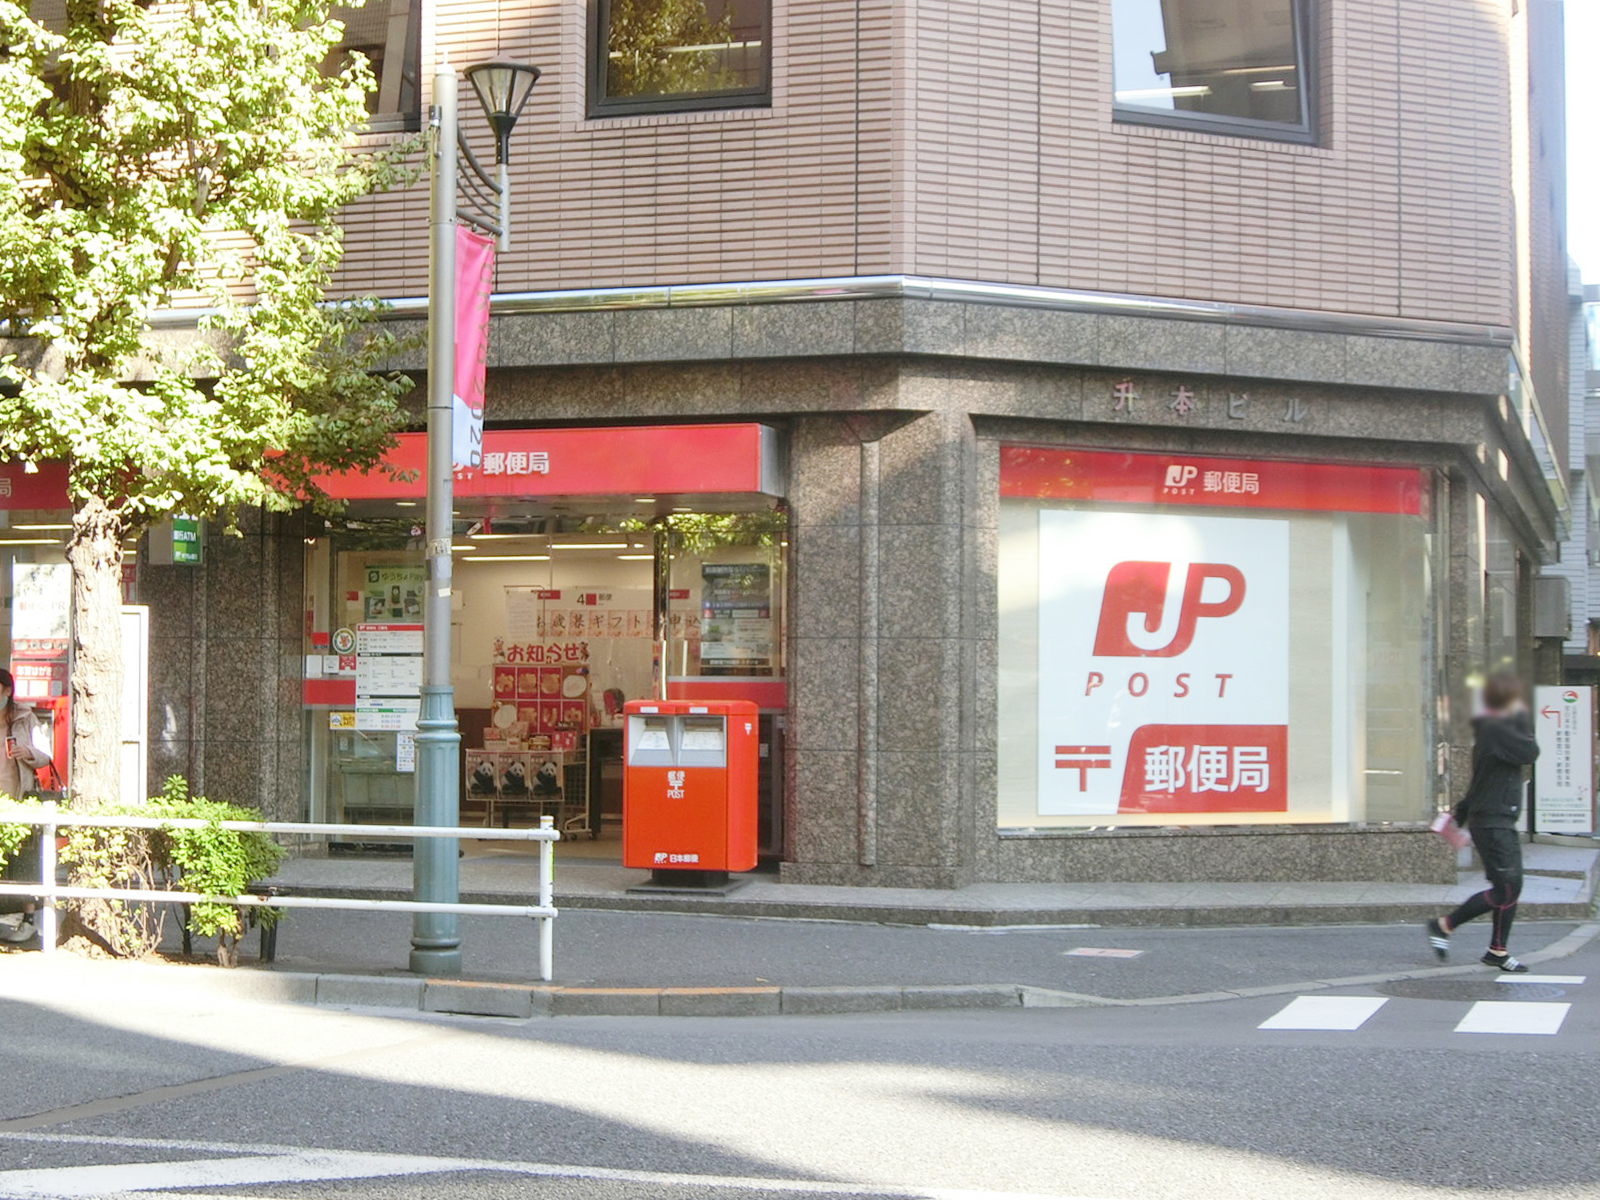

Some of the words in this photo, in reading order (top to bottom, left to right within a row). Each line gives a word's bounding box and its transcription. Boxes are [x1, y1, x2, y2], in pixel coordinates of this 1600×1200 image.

[1112, 380, 1309, 422] 升本ビル
[470, 375, 486, 469] 2020
[483, 451, 550, 476] 郵便局
[1163, 487, 1196, 496] POST
[1203, 470, 1260, 496] 郵便局
[537, 611, 701, 630] お歳暮ギフト申込
[507, 643, 580, 663] お知らせ
[1085, 671, 1234, 698] POST
[1143, 744, 1270, 793] 郵便局
[667, 790, 684, 799] POST
